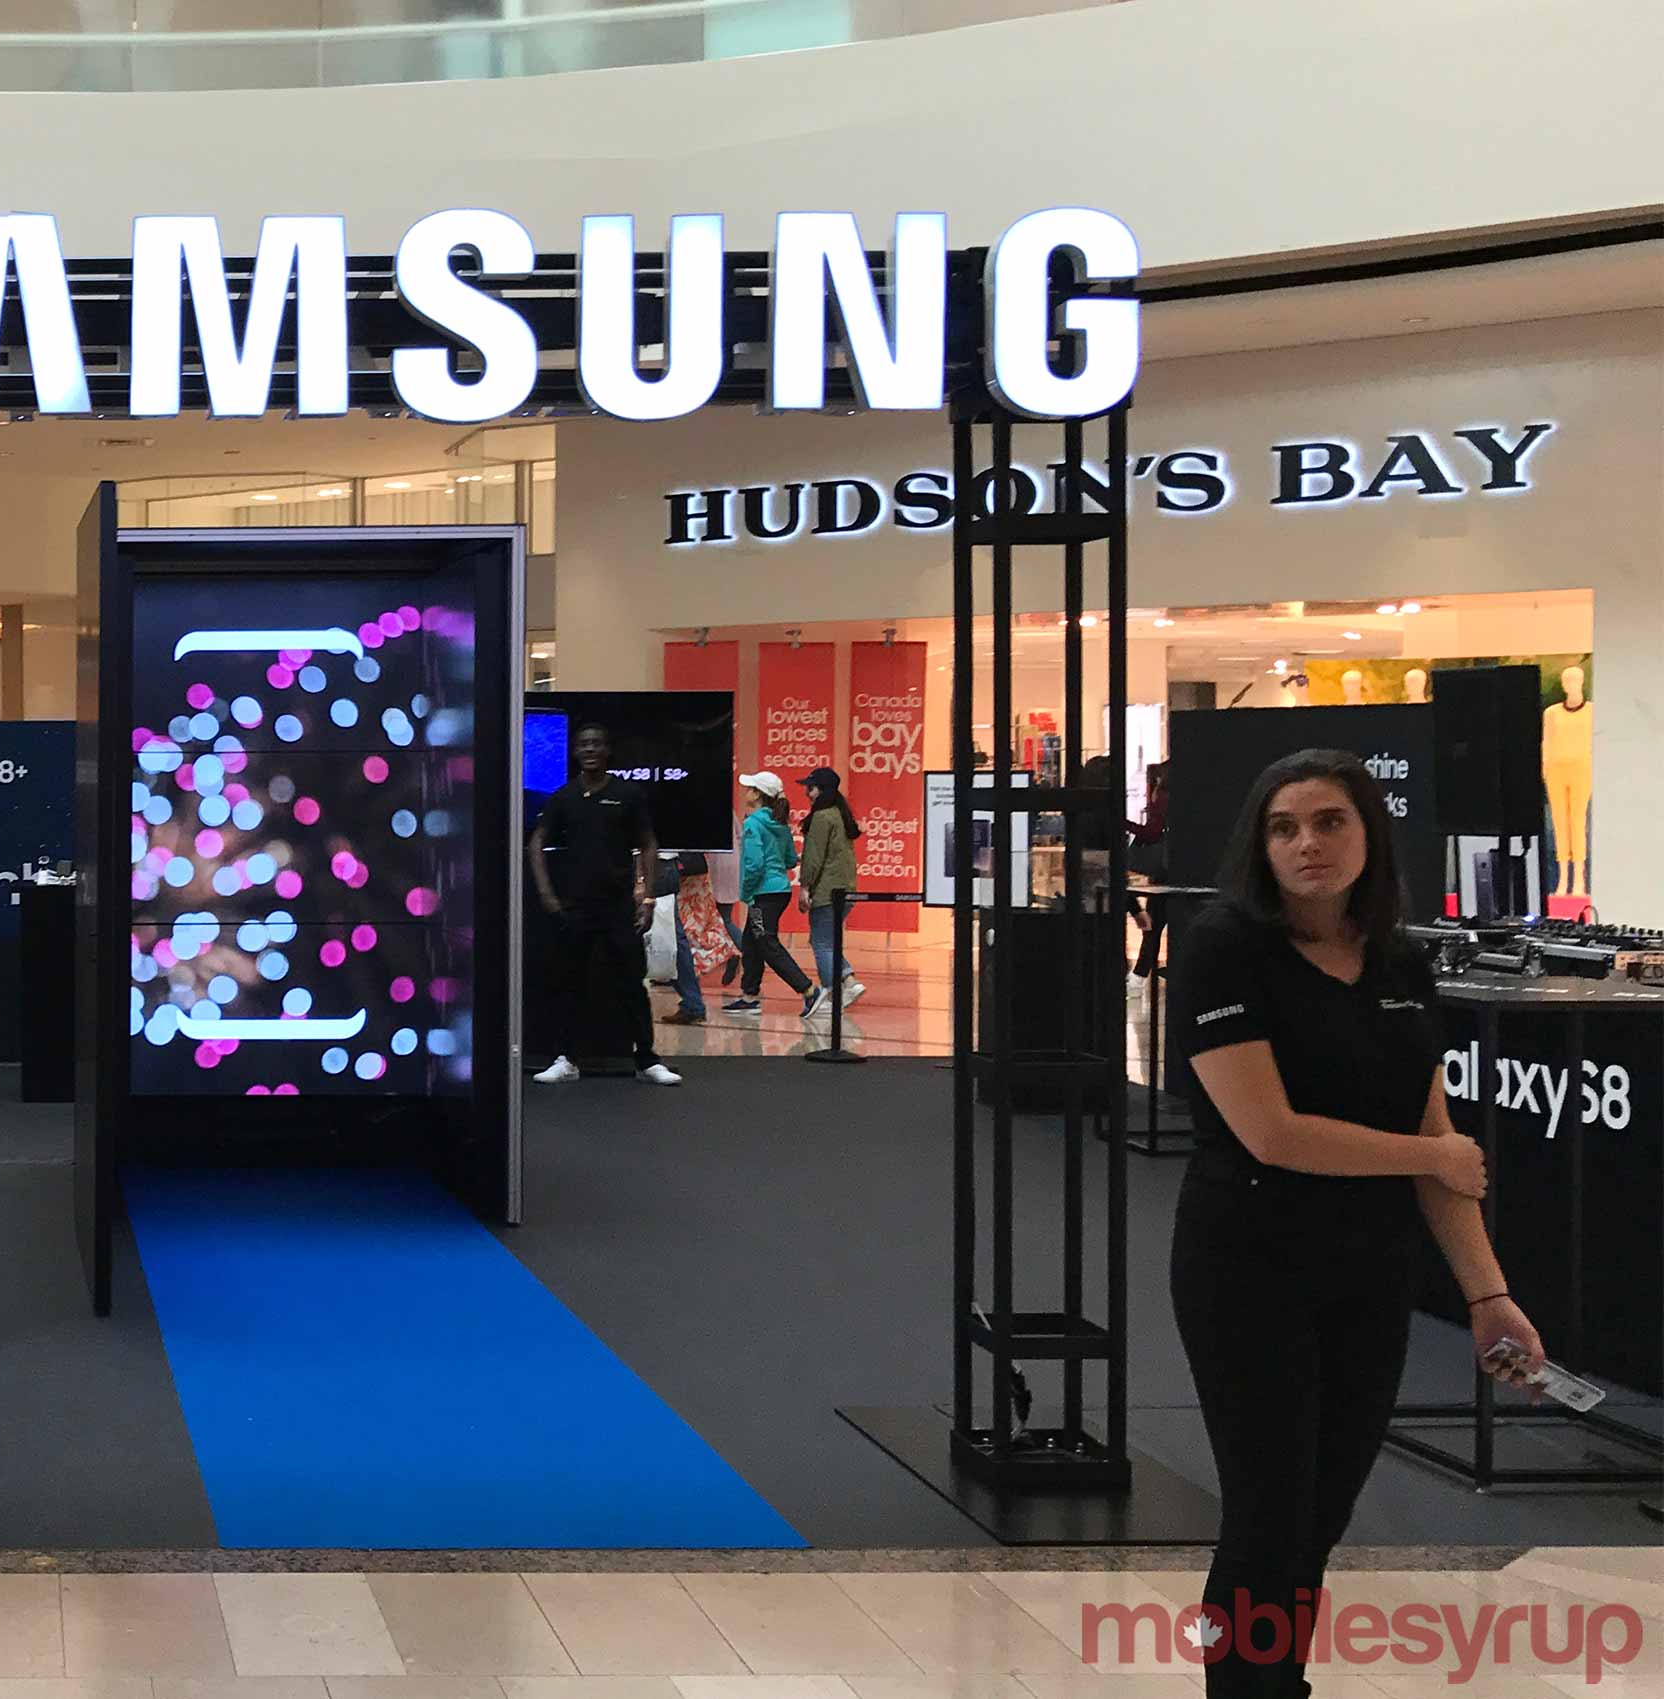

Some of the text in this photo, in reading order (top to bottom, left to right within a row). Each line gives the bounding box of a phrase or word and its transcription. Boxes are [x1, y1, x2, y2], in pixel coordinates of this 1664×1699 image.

[664, 423, 1554, 545] HUDSON'S BAY
[782, 697, 811, 710] Our
[854, 693, 922, 708] Canada
[766, 707, 829, 724] lowest
[871, 708, 913, 722] loves
[767, 725, 828, 746] prices
[852, 715, 923, 755] bay
[778, 743, 817, 754] of the
[763, 754, 831, 768] season
[849, 746, 922, 780] days
[870, 807, 899, 820] Our
[866, 836, 905, 853] sale
[866, 852, 904, 864] of the
[1196, 1004, 1245, 1025] SAMSUNG
[1581, 1059, 1631, 1130] S8
